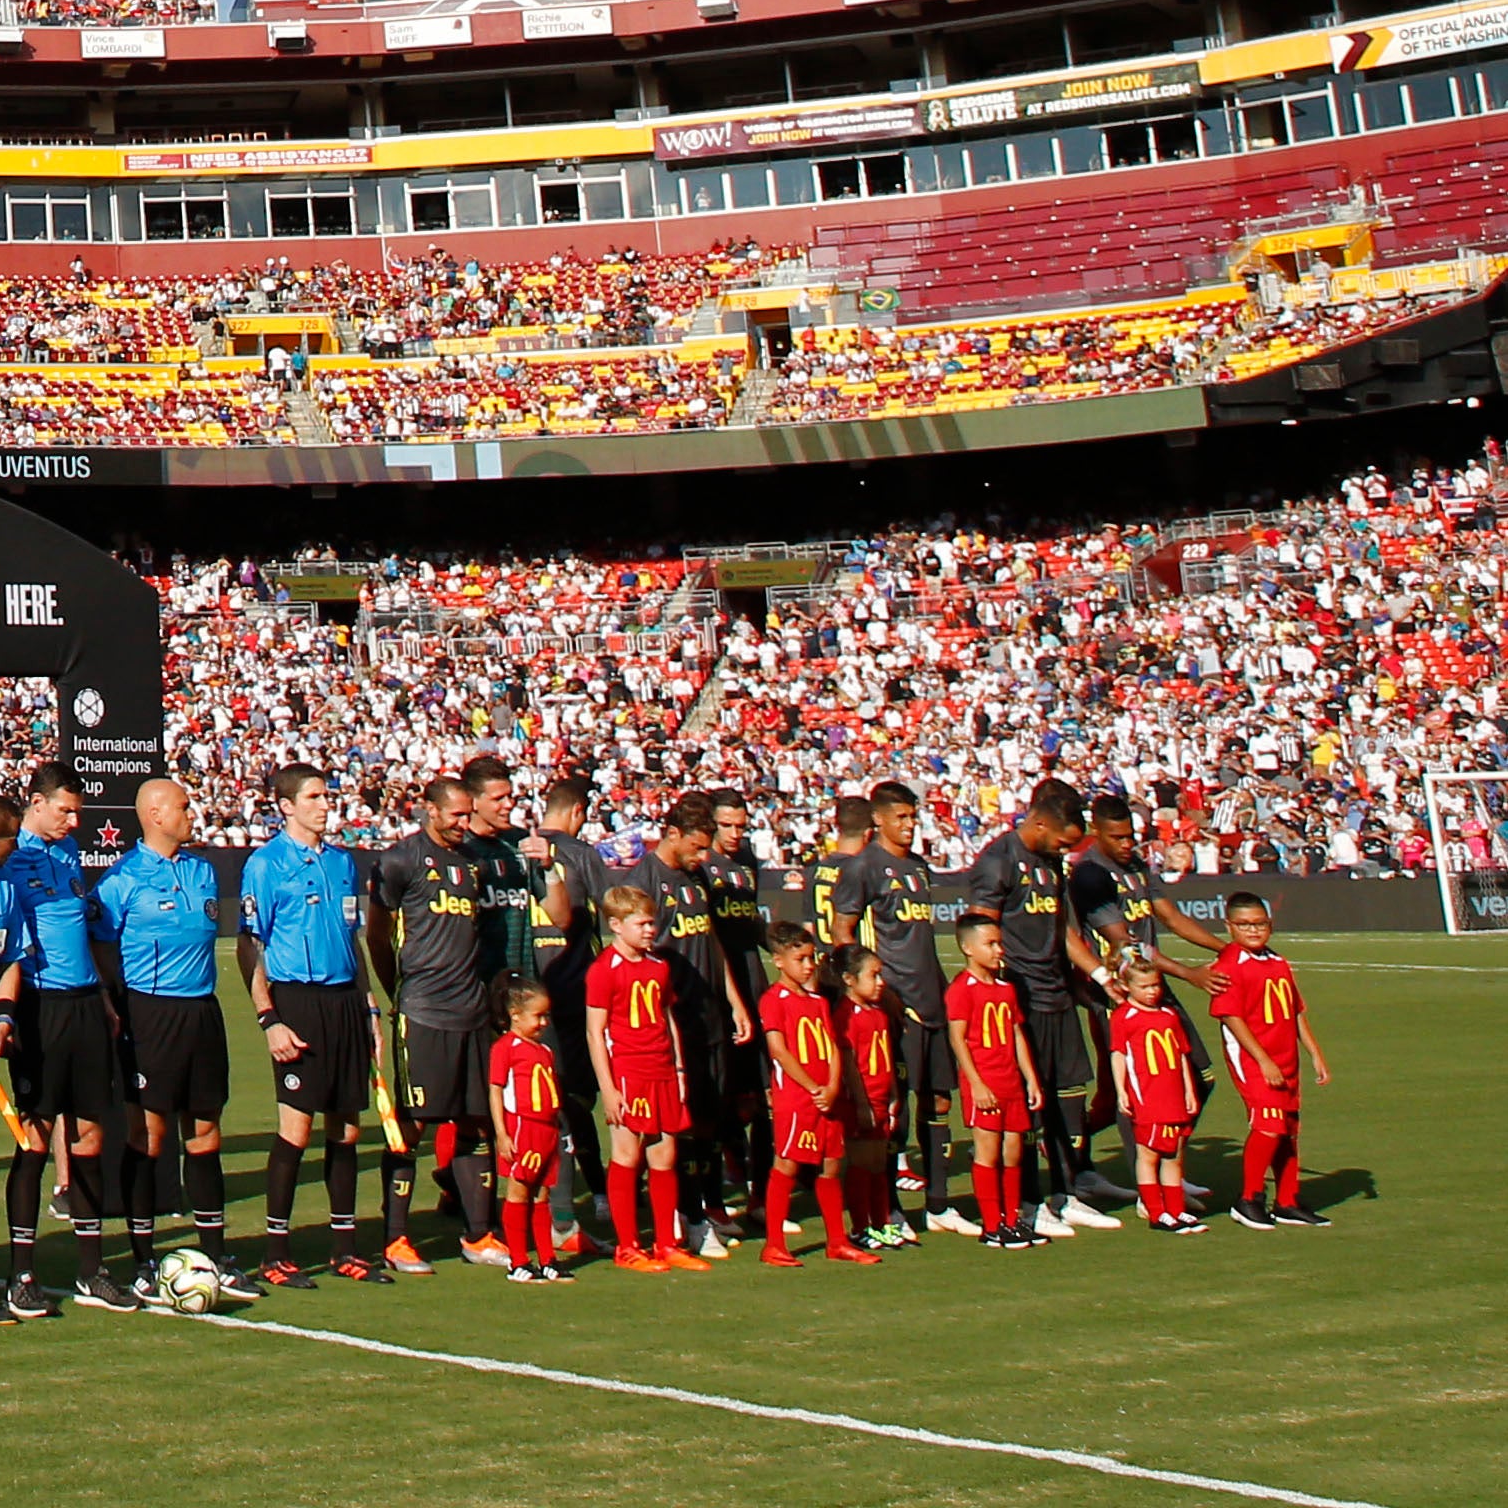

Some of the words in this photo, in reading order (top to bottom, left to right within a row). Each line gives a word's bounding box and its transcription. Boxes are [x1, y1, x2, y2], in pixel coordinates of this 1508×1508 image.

[1399, 19, 1460, 40] OFFICIAL
[1401, 42, 1421, 55] OF
[1425, 37, 1451, 50] THE
[1061, 76, 1105, 99] JOIN
[1107, 73, 1152, 92] NOW
[951, 103, 1018, 126] SALUTE
[1026, 103, 1043, 116] AT
[748, 133, 779, 145] JOIN
[781, 129, 811, 141] NOW
[190, 153, 240, 163] NEED
[1183, 543, 1209, 558] 229
[5, 584, 64, 626] HERE.
[74, 735, 157, 753] International
[74, 756, 151, 776] Champions
[81, 778, 103, 797] up
[429, 889, 473, 917] Jee
[896, 898, 932, 922] Jee
[1025, 890, 1057, 914] Jee
